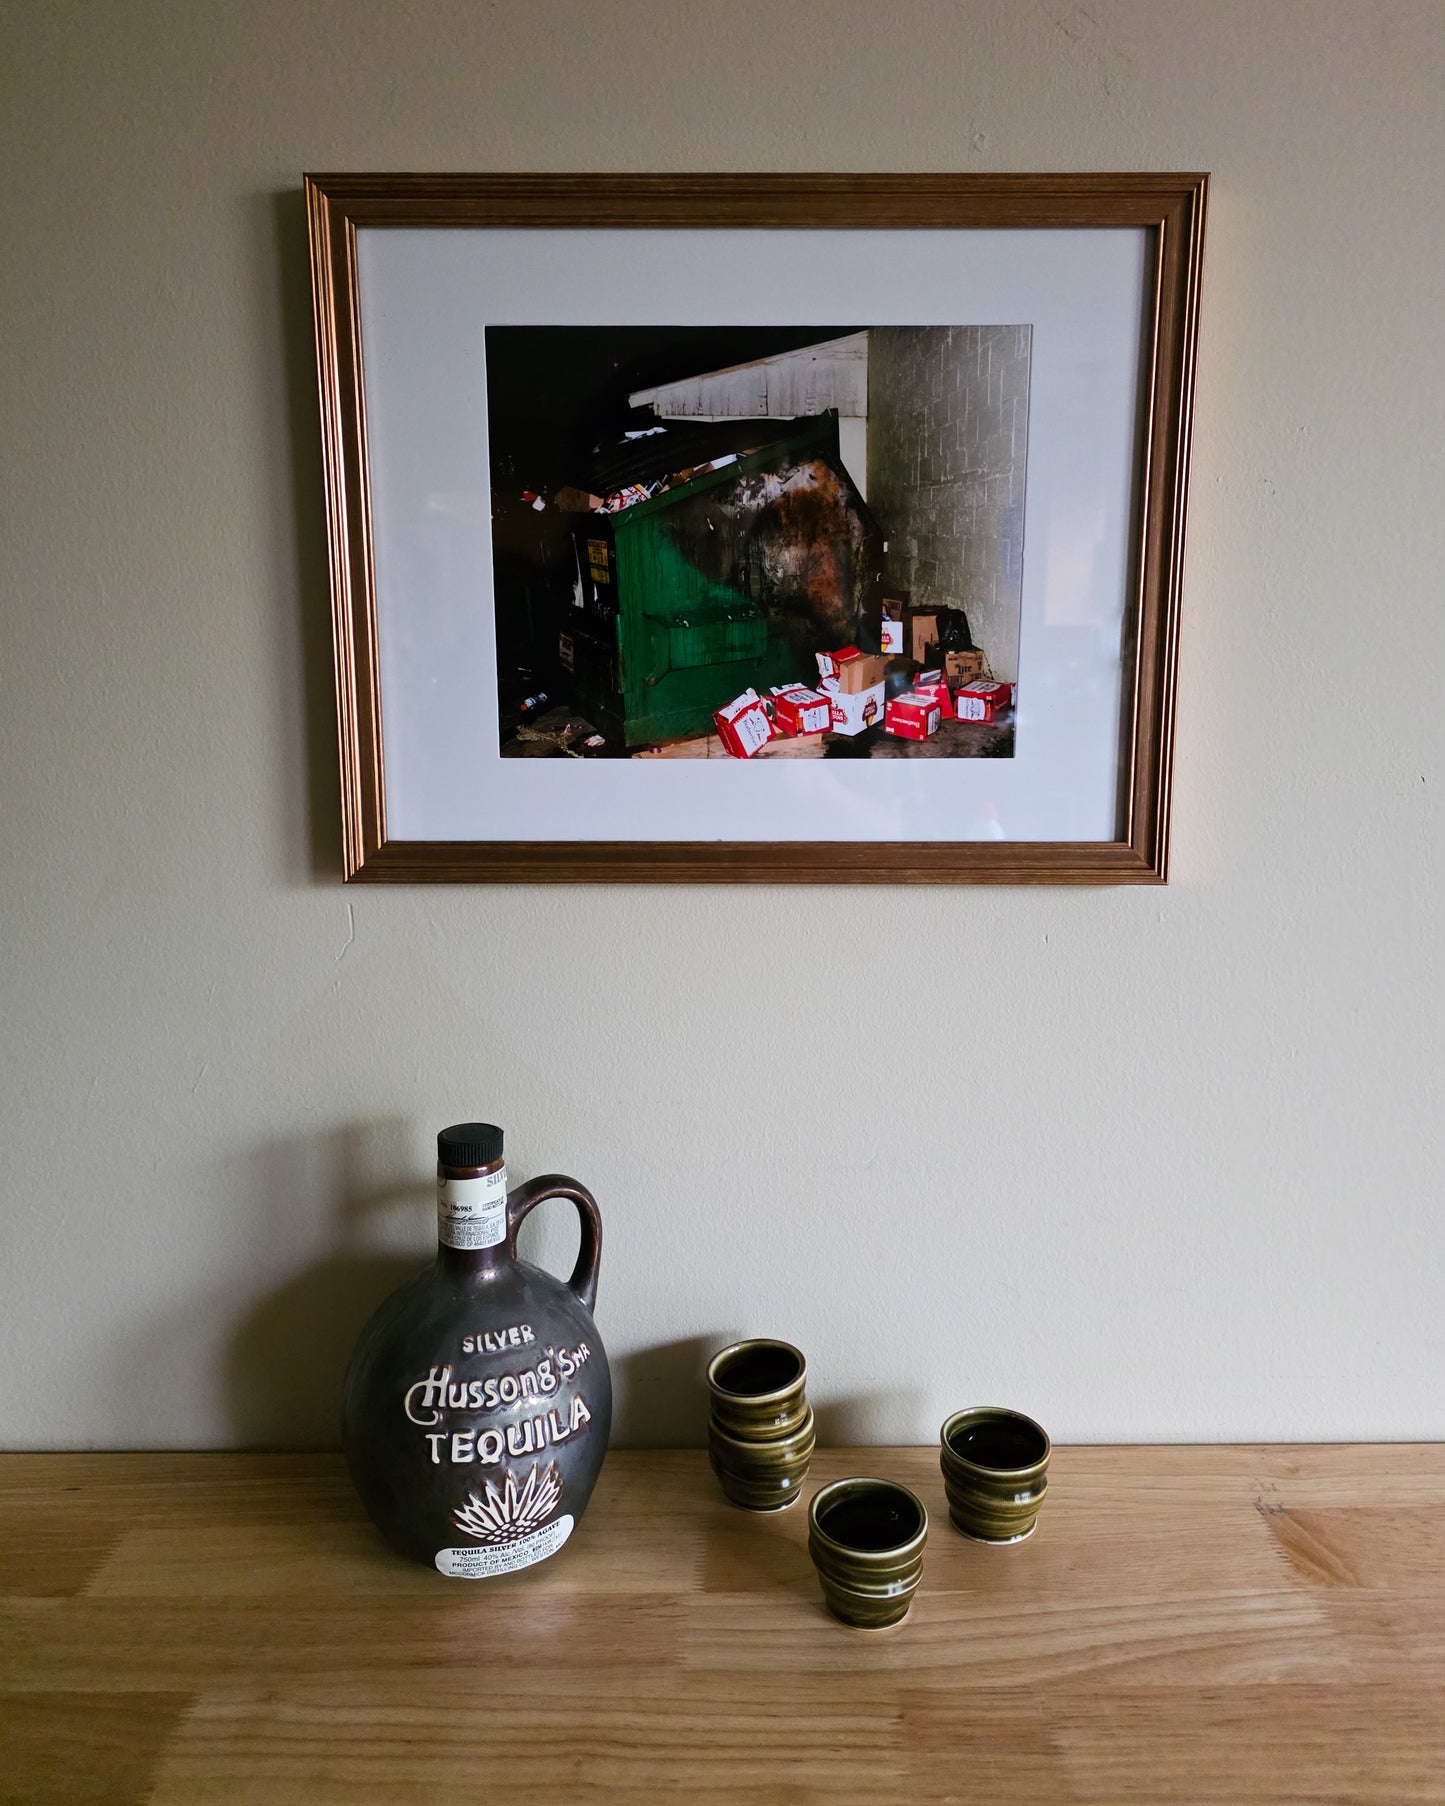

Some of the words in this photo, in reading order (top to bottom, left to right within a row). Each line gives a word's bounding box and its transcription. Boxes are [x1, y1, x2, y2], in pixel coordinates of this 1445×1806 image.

[892, 716, 920, 729] Budweiser
[462, 1324, 535, 1353] SILVER
[424, 1394, 591, 1464] TEQUILA
[451, 1548, 487, 1556] TEQUILA
[489, 1542, 517, 1552] SILVER
[519, 1535, 536, 1545] 100%
[538, 1520, 560, 1537] AGAVE
[502, 1550, 528, 1562] MEXICO
